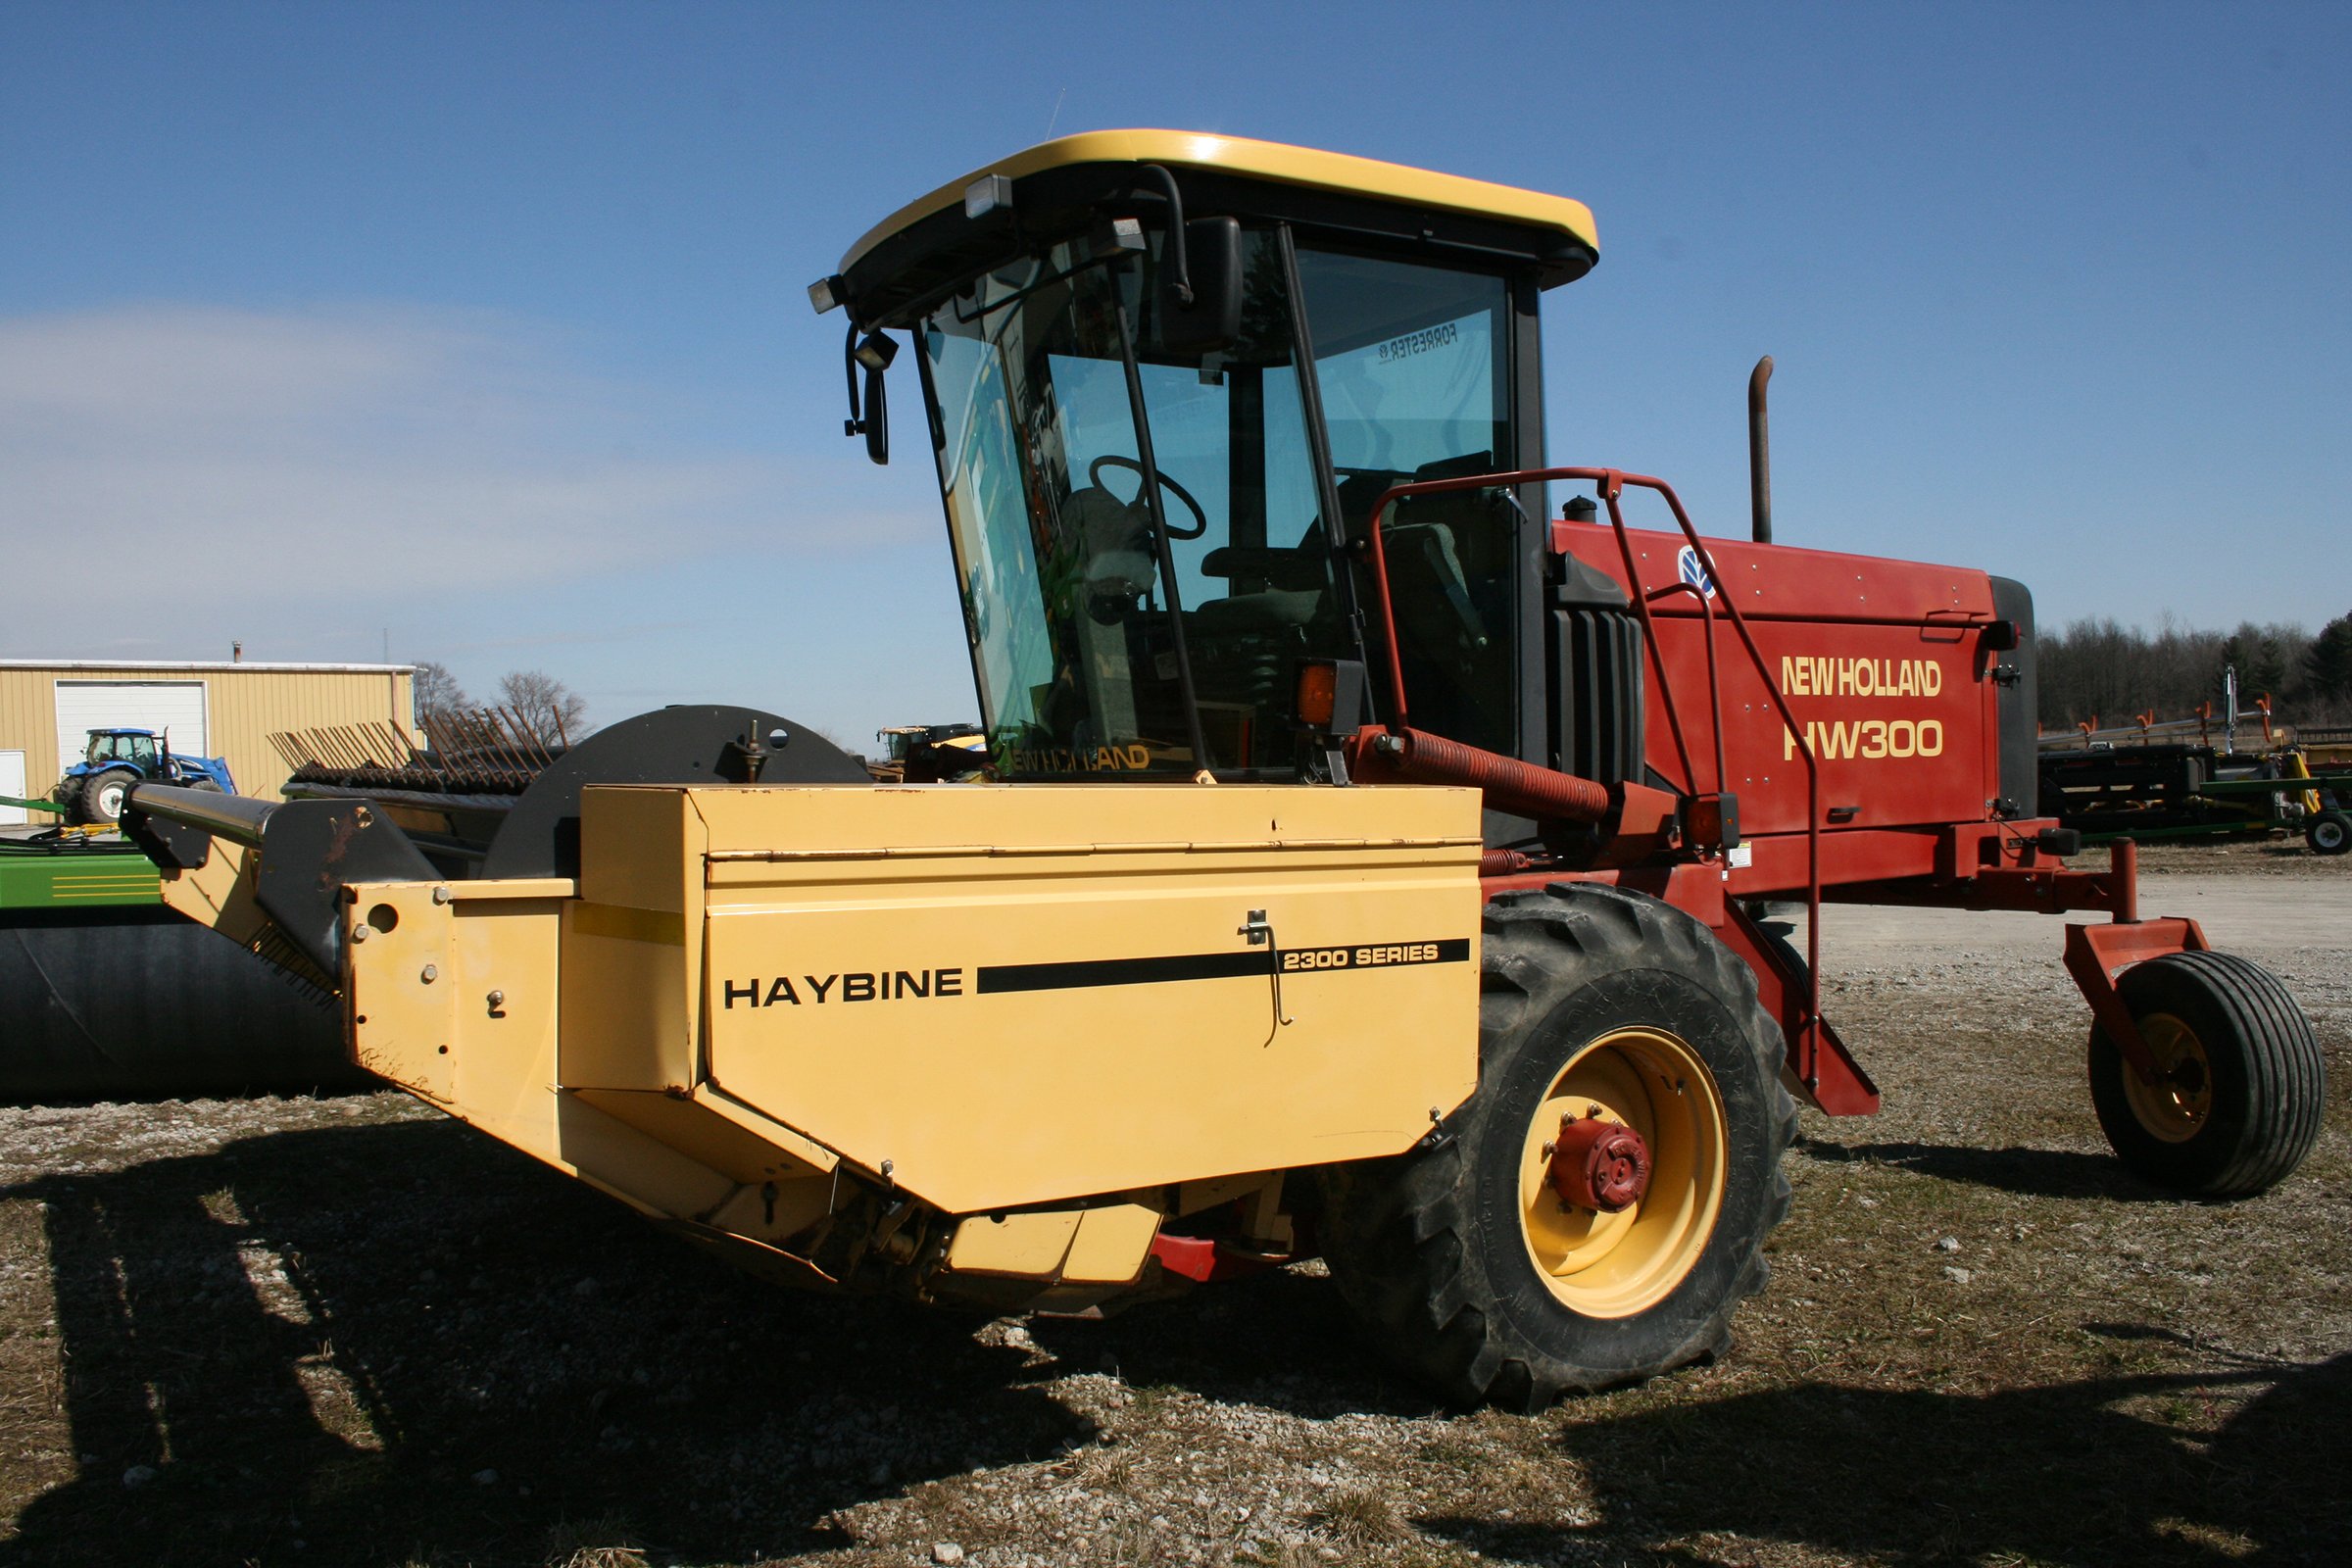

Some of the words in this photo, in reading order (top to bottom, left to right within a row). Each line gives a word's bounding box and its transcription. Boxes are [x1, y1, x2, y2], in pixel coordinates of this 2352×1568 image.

[1782, 656, 1835, 696] NEW
[1838, 658, 1942, 698] HOLLAND
[1784, 719, 1943, 761] HW300
[724, 967, 962, 1009] HAYBINE
[1283, 950, 1348, 970] 2300
[1355, 944, 1439, 965] SERIES
